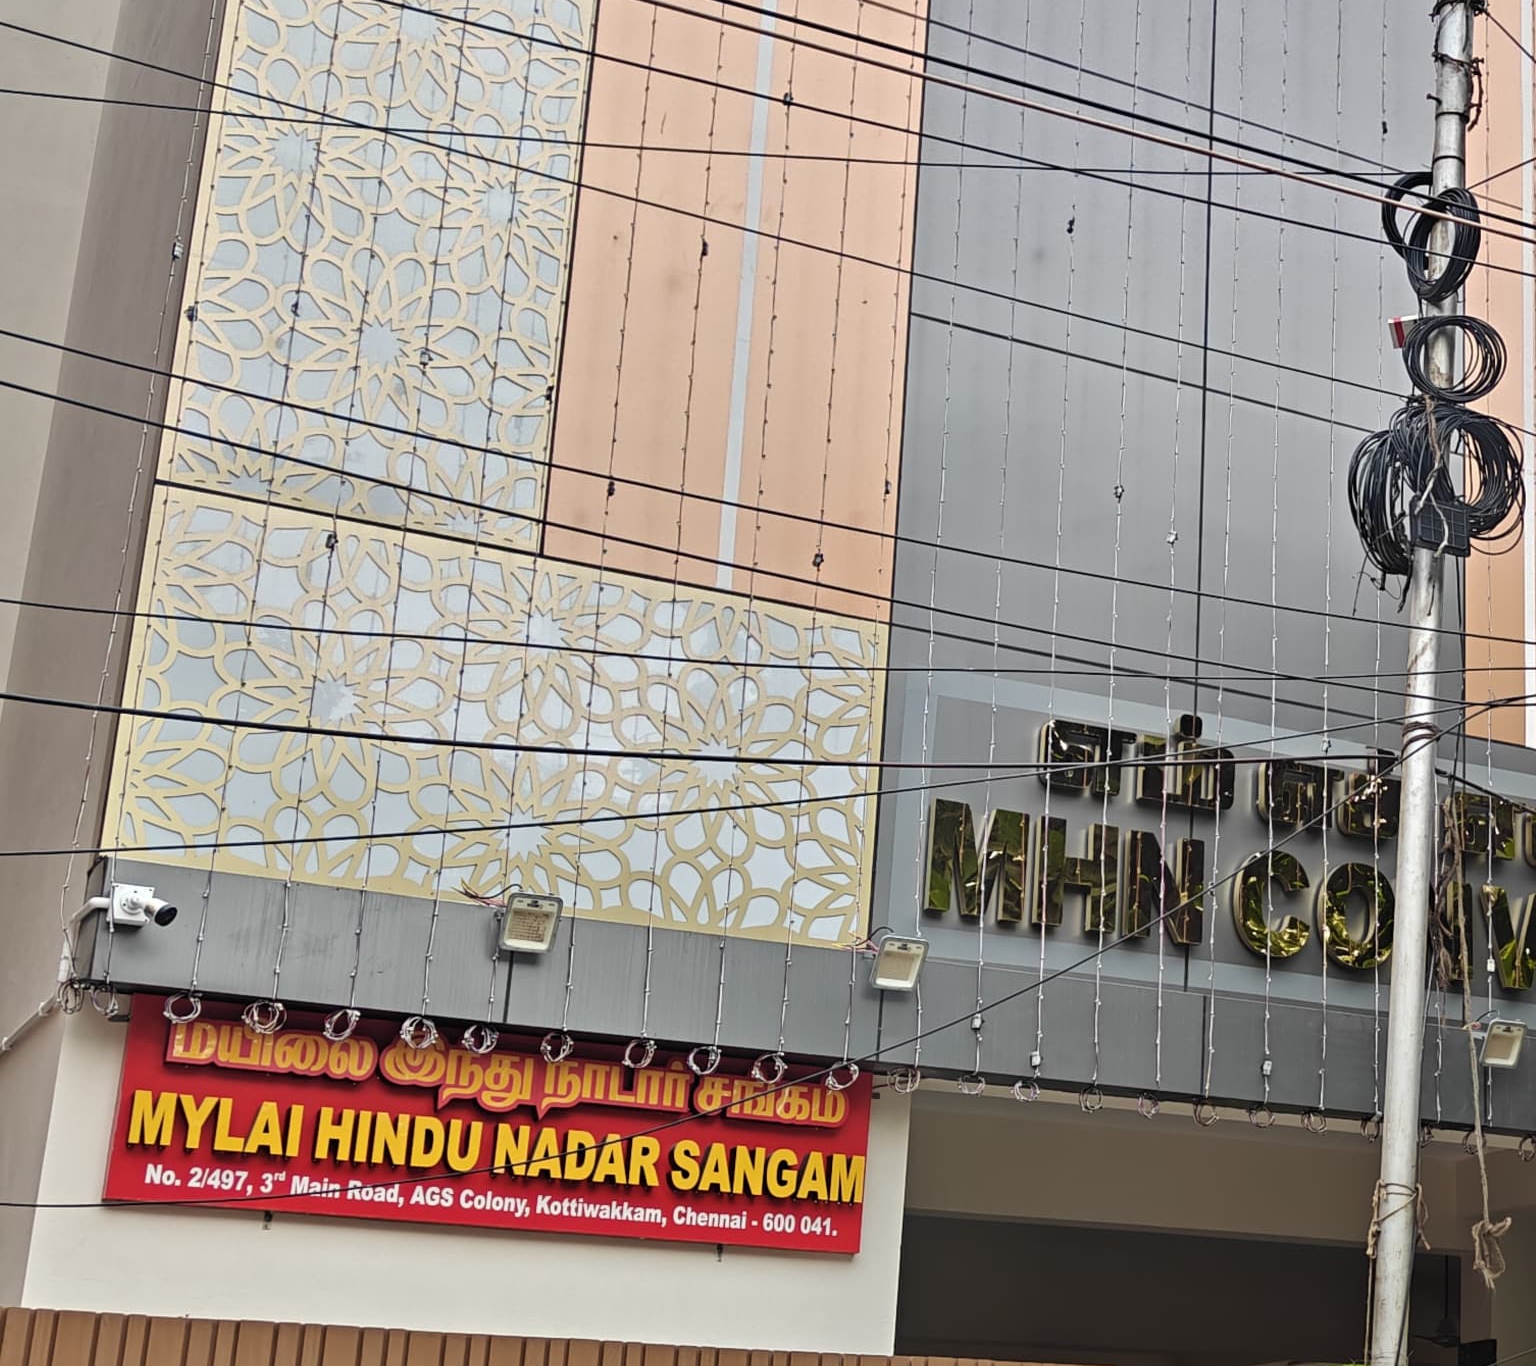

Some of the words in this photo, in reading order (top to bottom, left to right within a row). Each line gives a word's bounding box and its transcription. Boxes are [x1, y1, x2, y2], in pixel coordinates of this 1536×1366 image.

[924, 798, 1205, 946] MHN
[170, 1019, 376, 1077] மயிலை
[384, 1032, 533, 1106] இந்து
[541, 1057, 690, 1111] நாடார்
[127, 1089, 305, 1158] MYLAI
[314, 1106, 483, 1173] HINDU
[493, 1122, 661, 1187] NADAR
[669, 1139, 865, 1204] SANGAM
[145, 1163, 181, 1186] No.
[188, 1167, 253, 1196] 2/497,
[259, 1170, 287, 1194] 3rd
[290, 1175, 341, 1198] Main
[348, 1180, 404, 1208] Road,
[410, 1185, 455, 1207] AGS
[459, 1188, 530, 1217] Colony,
[535, 1195, 667, 1228] Kottiwakkam,
[673, 1205, 747, 1230] Chennai
[763, 1213, 796, 1234] 600
[800, 1215, 838, 1237] 041.
